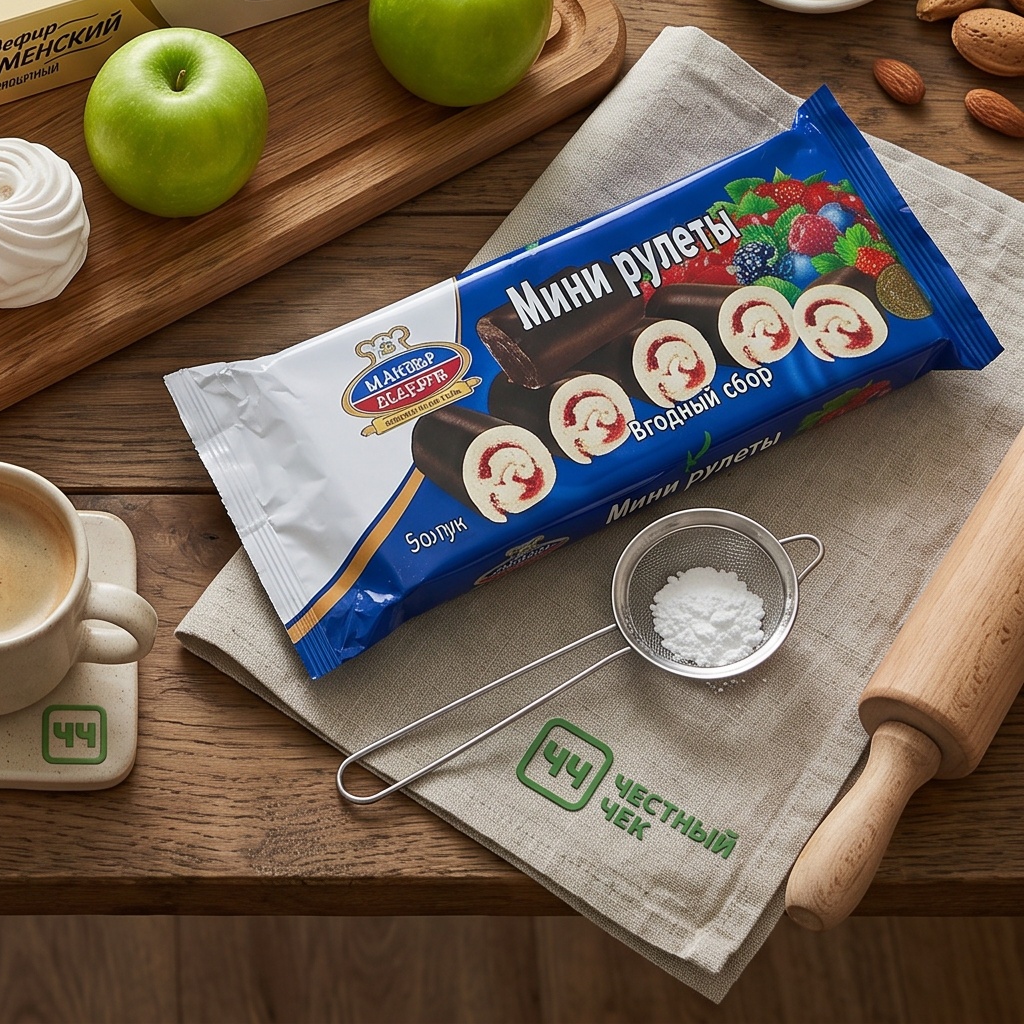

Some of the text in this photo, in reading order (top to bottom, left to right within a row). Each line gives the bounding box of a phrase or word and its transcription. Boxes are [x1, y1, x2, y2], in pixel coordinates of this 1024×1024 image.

[505, 208, 741, 331] Мини рулеты
[722, 366, 774, 399] сбор
[605, 431, 782, 525] Мини рулеты
[599, 798, 652, 841] ЧЕК
[613, 773, 741, 859] ЧЕСТНЫЙ
